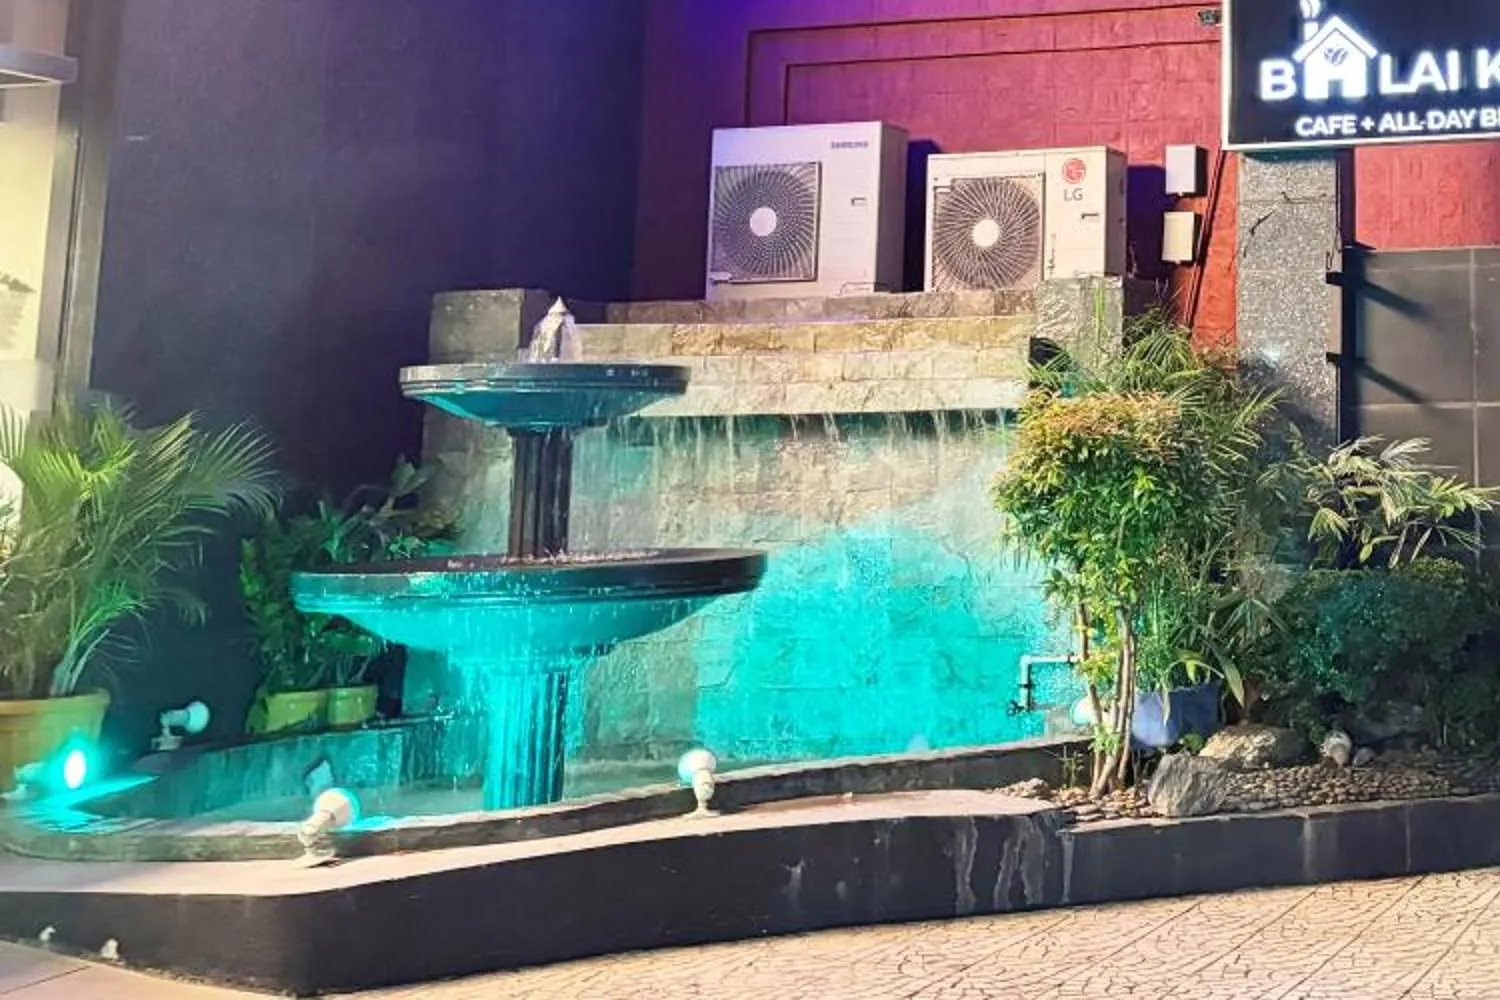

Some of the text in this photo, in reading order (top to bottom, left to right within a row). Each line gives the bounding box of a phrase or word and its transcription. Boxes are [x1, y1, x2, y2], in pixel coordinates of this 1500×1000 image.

[1294, 114, 1357, 137] CAFE
[1378, 107, 1477, 134] ALL-DAY
[1063, 187, 1084, 202] LG
